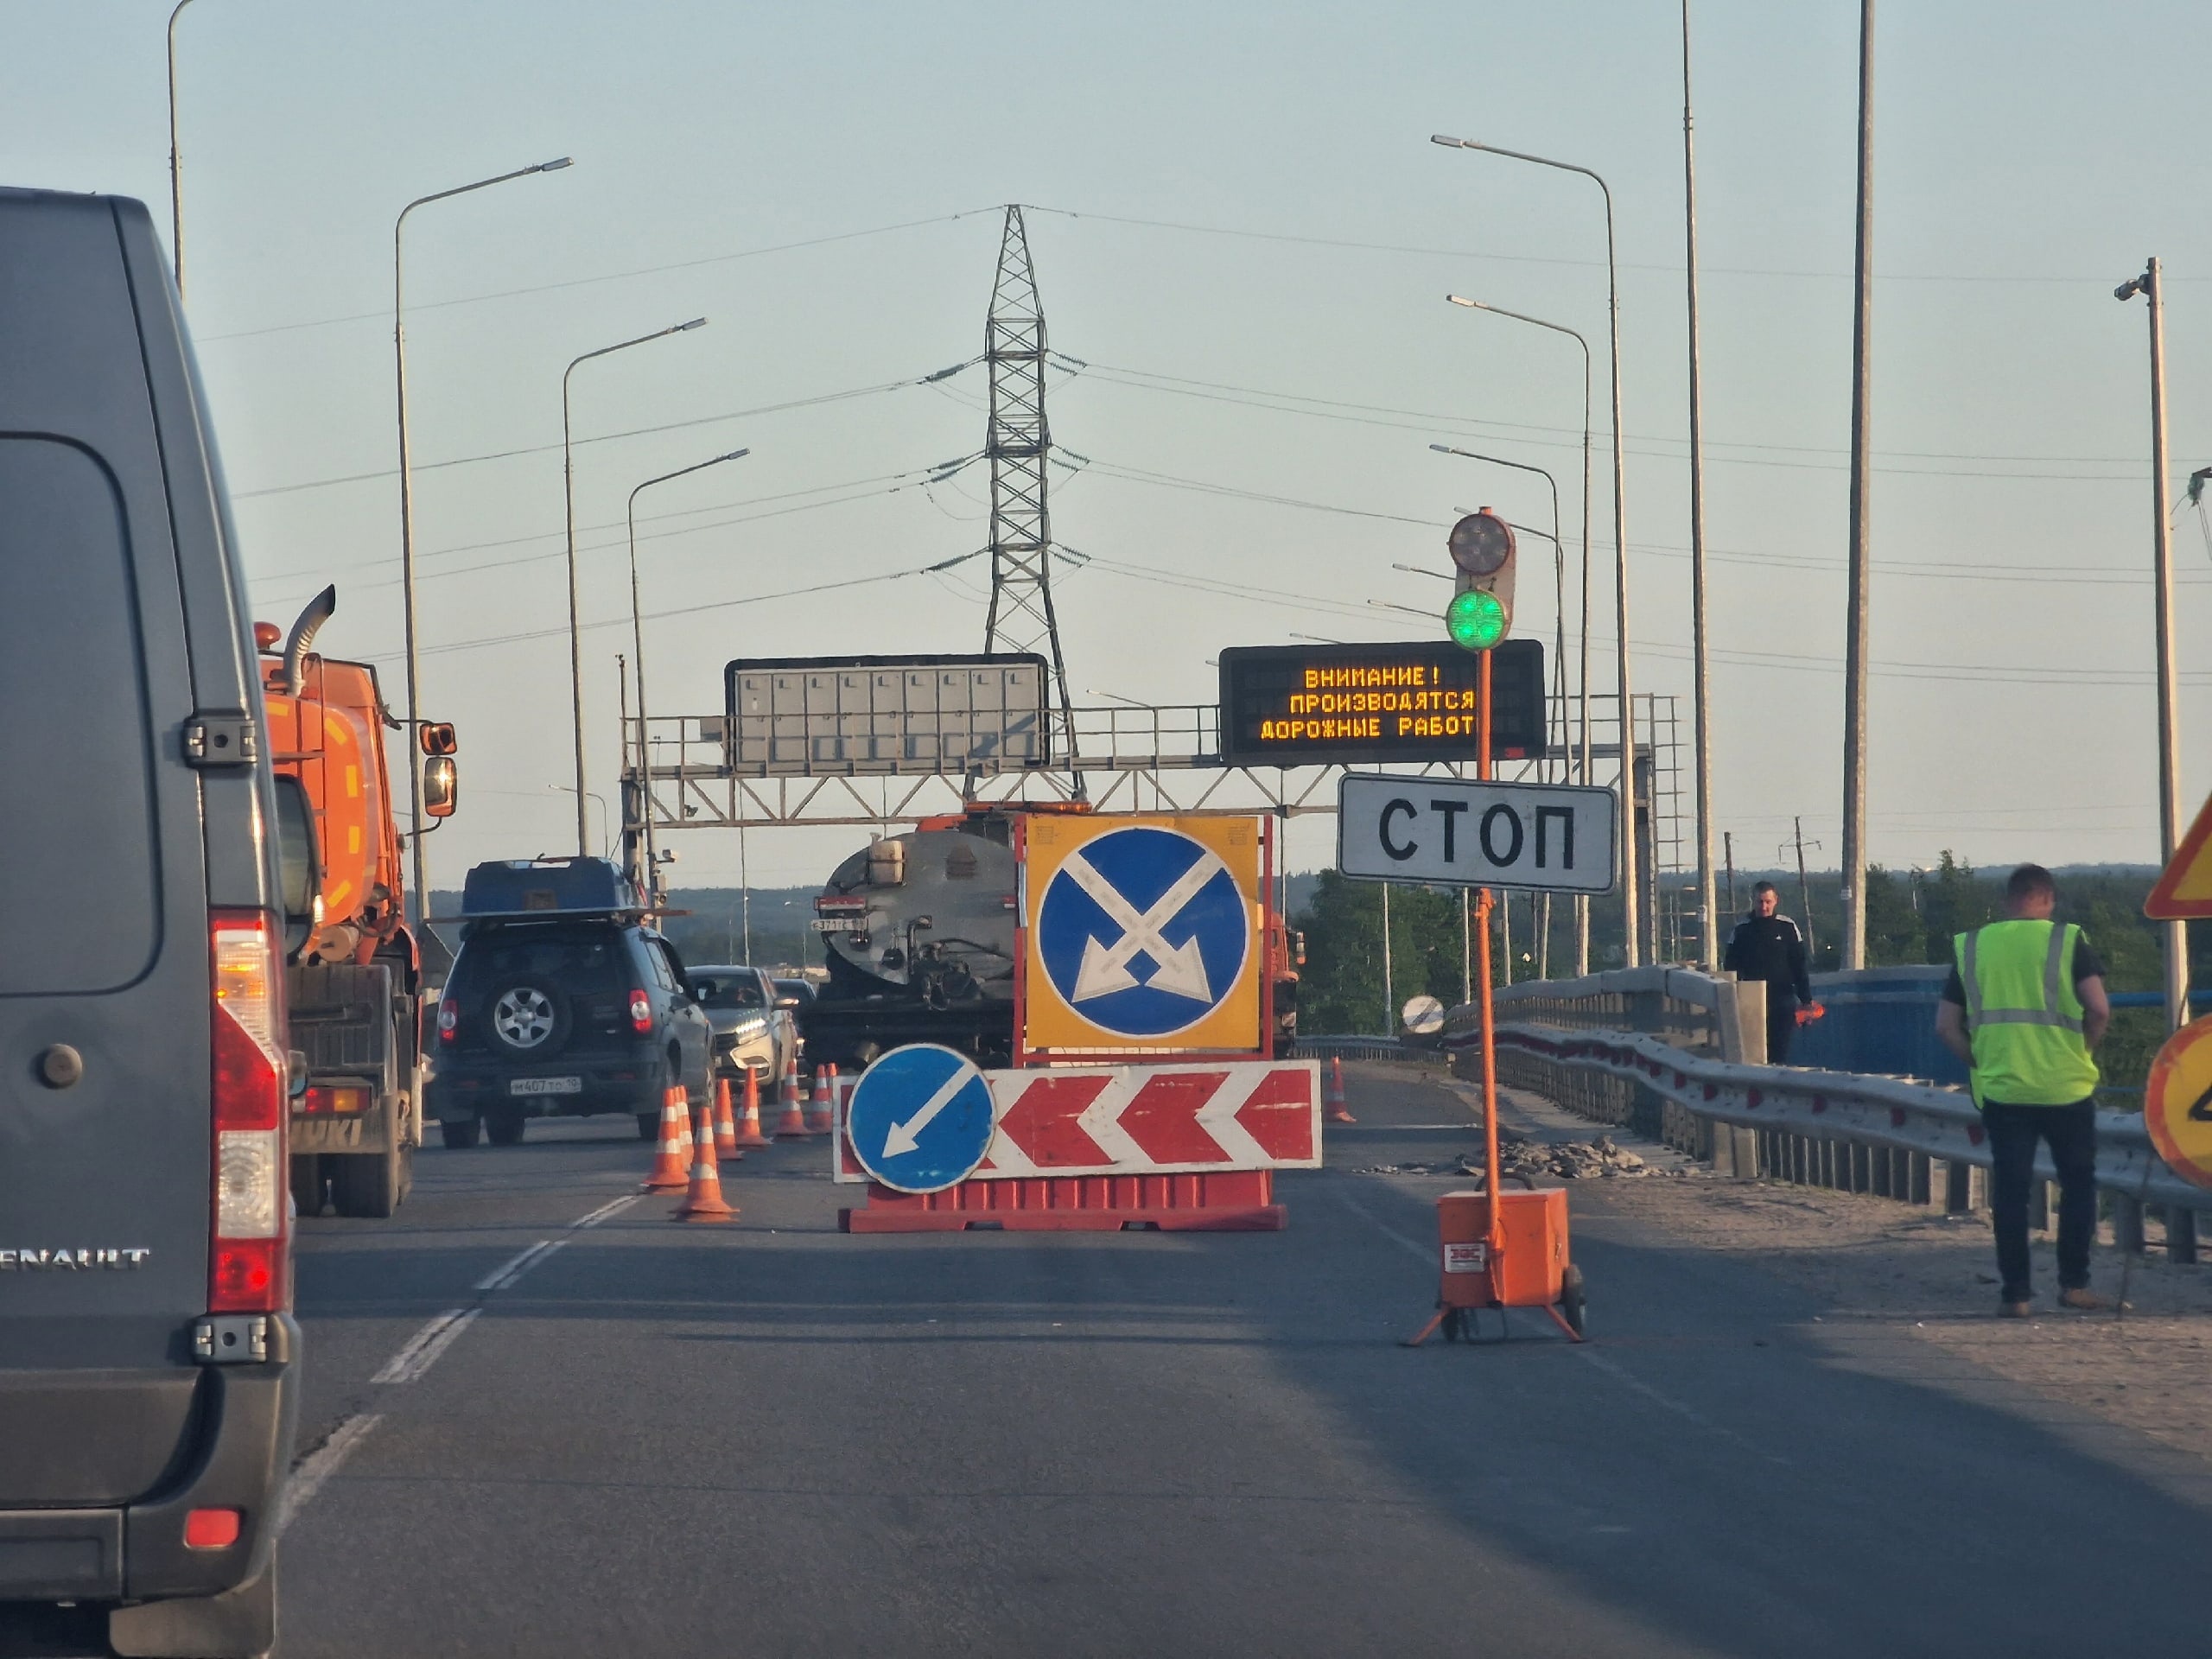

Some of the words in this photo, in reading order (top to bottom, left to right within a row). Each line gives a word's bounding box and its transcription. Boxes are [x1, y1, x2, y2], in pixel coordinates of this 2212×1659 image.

[1289, 691, 1475, 714] ПРОИЗВОДЯТСЯ
[1261, 717, 1381, 740] ДОРОЖНЫЕ
[1398, 715, 1475, 736] РАБОТ
[1379, 798, 1574, 870] СТОП
[0, 1249, 149, 1271] ENAULT
